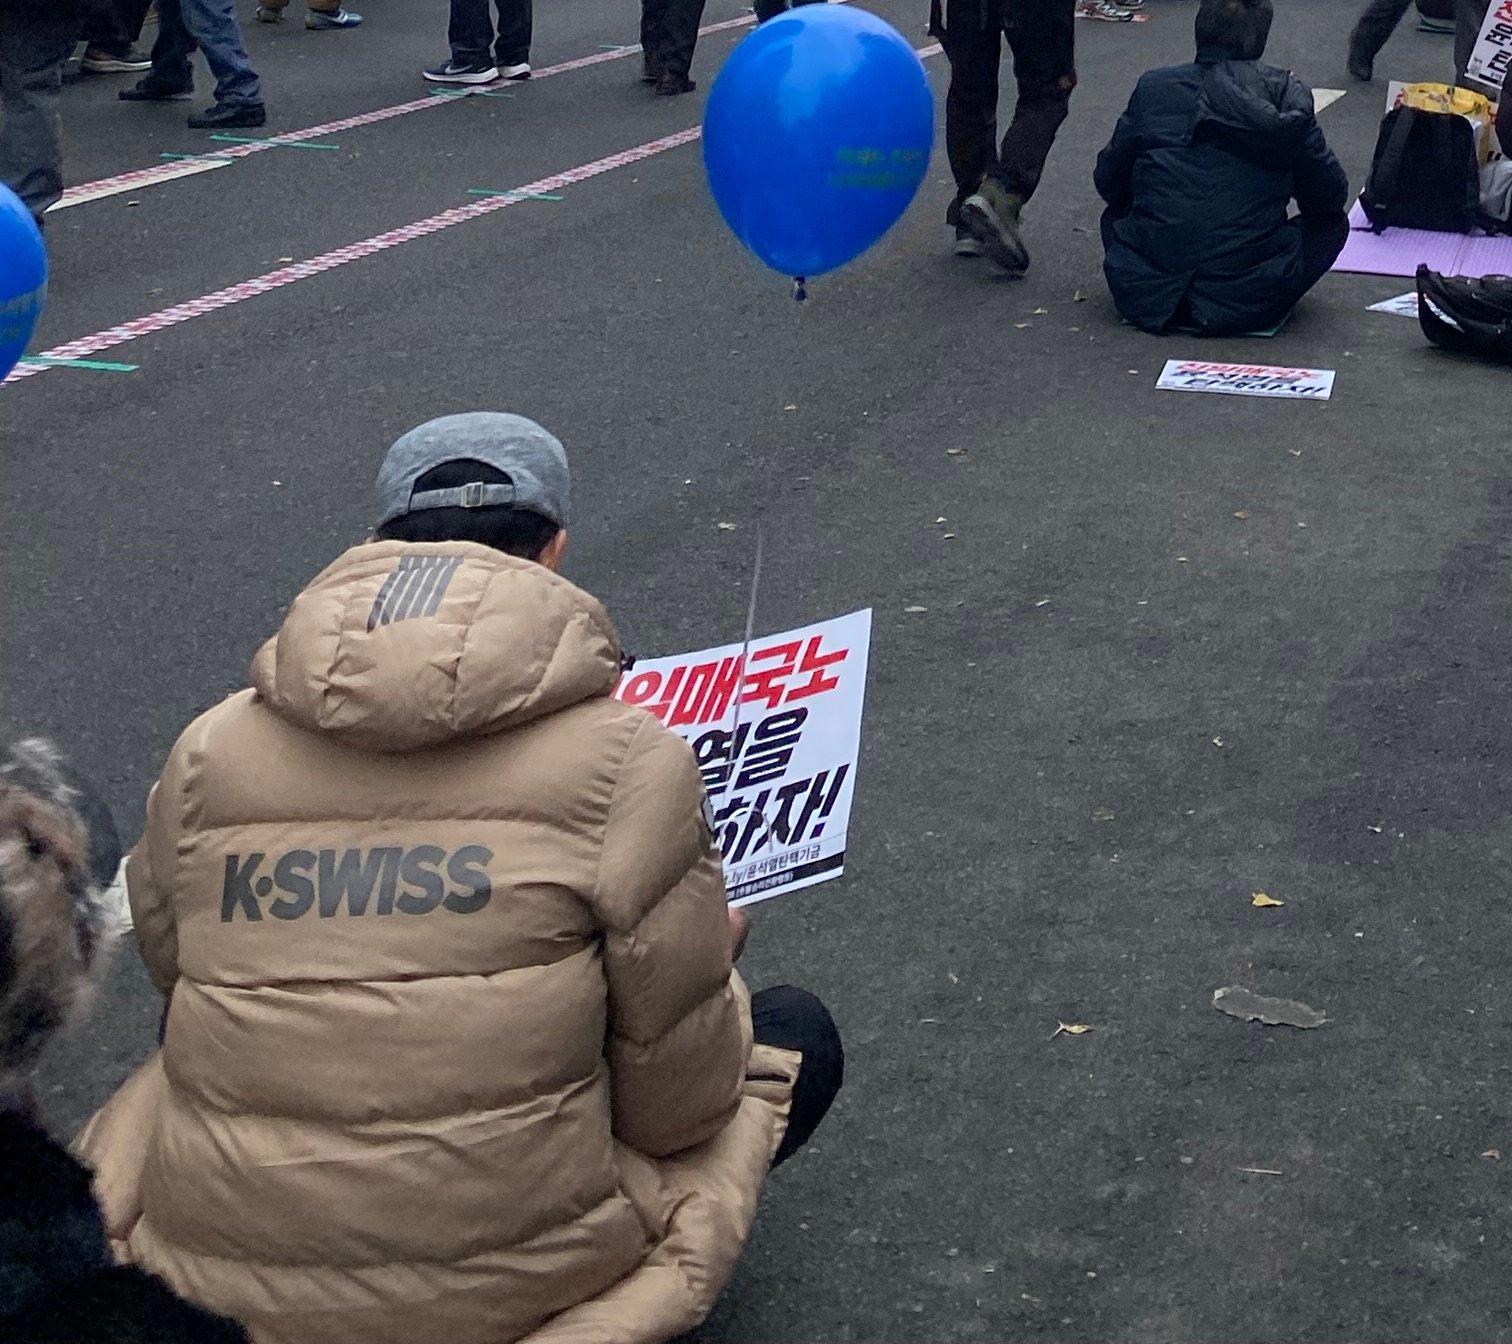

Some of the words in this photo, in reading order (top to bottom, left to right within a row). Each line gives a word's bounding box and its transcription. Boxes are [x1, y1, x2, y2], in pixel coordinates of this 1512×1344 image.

[611, 635, 850, 728] 일매국노
[684, 706, 809, 797] 열을
[712, 763, 851, 865] 하자!
